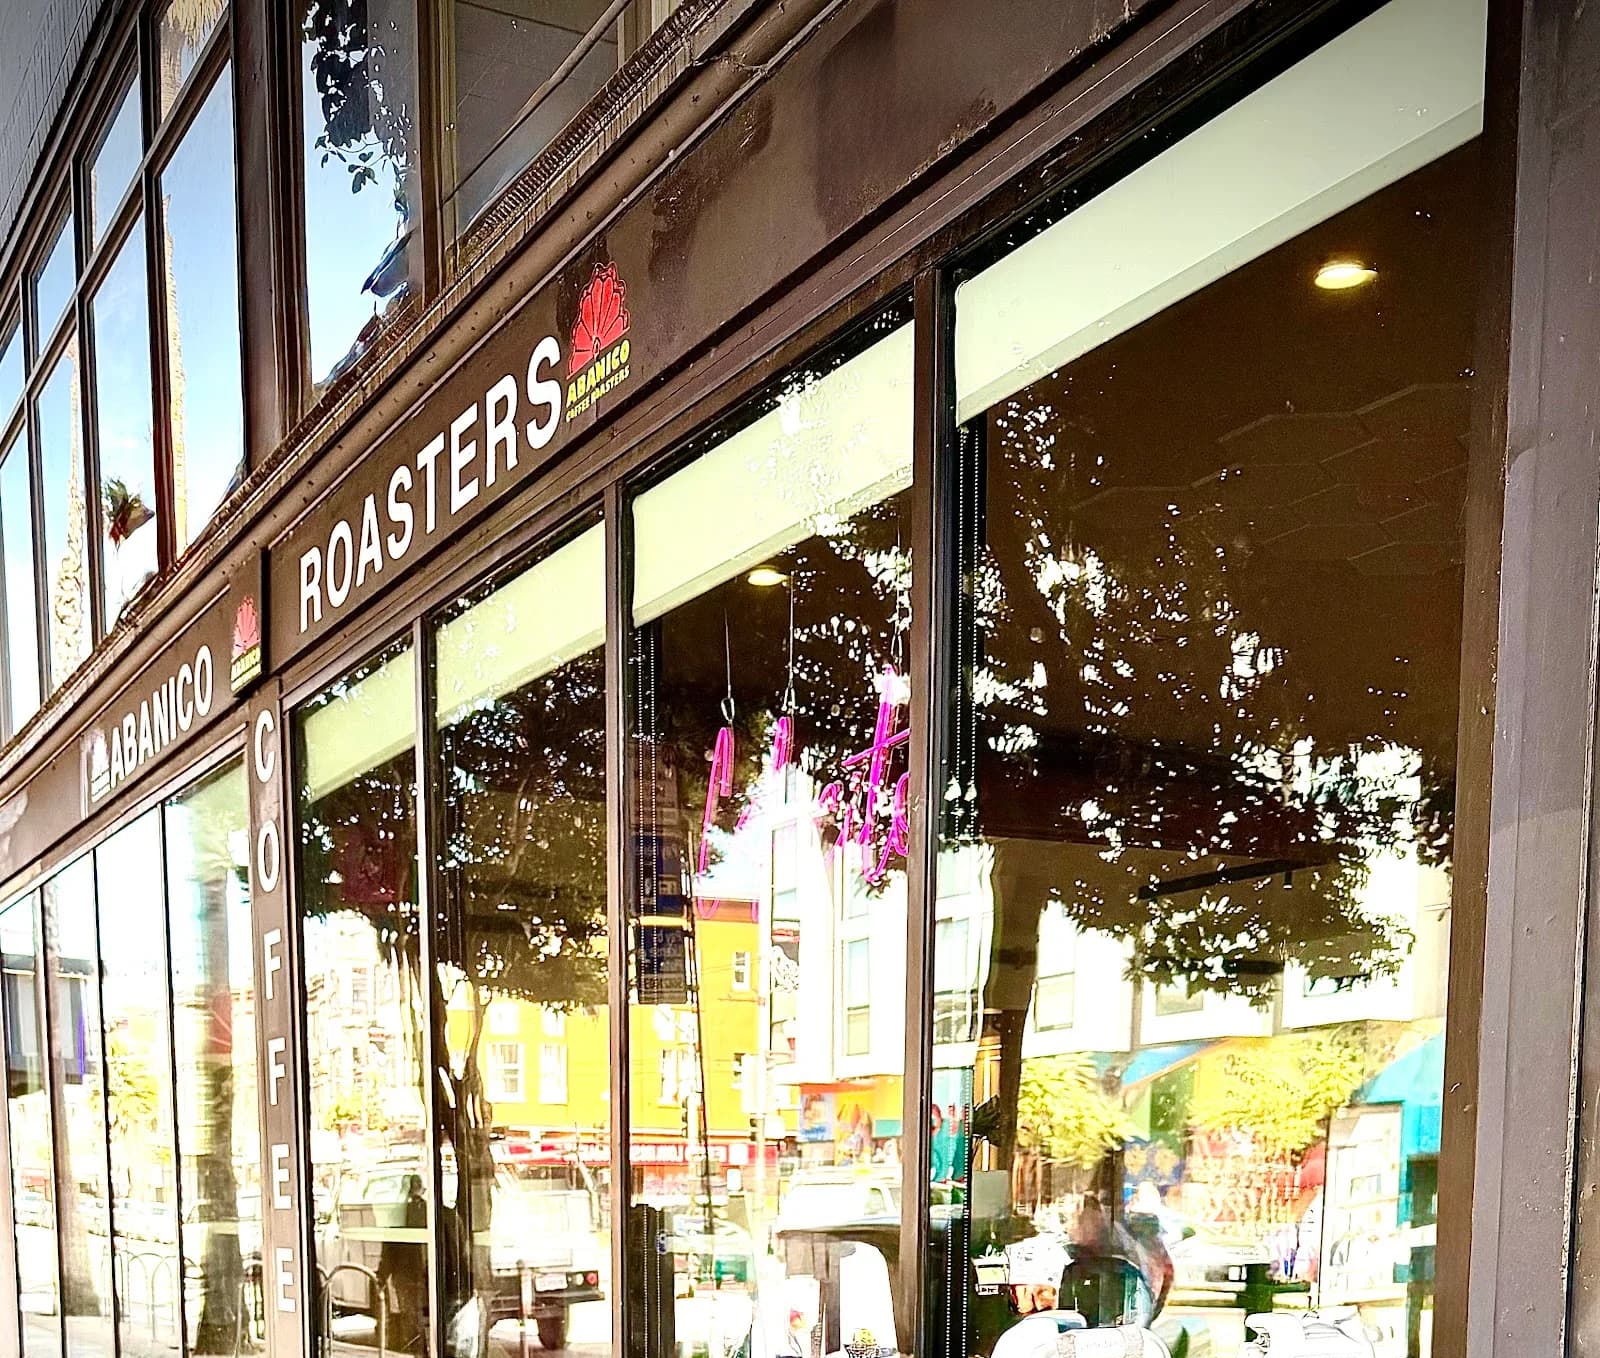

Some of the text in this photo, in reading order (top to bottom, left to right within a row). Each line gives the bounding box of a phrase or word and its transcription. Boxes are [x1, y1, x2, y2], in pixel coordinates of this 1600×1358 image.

[566, 339, 630, 409] ABANICO
[300, 336, 562, 634] ROASTERS
[110, 645, 214, 790] ABANICO
[254, 709, 296, 1314] COFFEE
